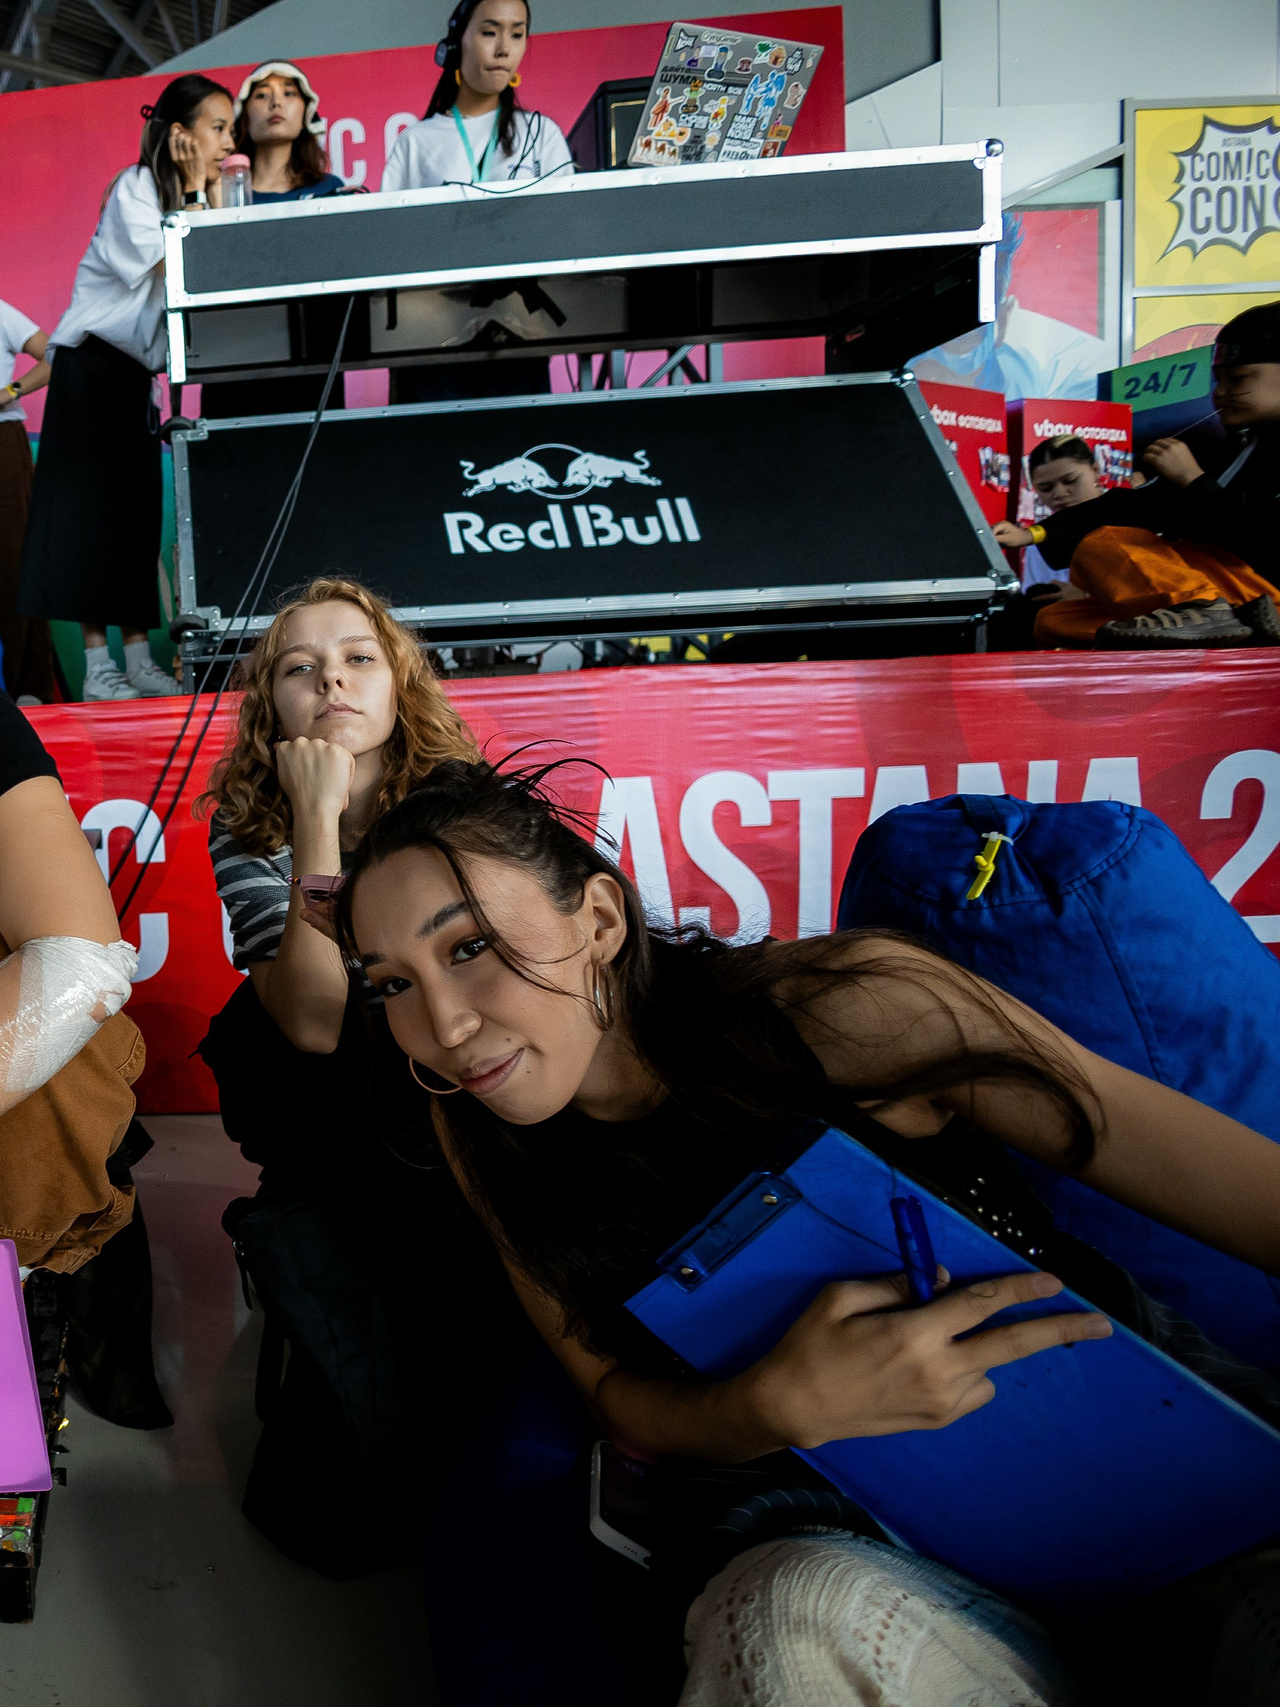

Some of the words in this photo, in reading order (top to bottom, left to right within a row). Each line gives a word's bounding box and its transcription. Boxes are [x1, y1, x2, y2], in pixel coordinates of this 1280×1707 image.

[1190, 185, 1266, 235] CON
[1124, 361, 1198, 400] 24/7
[442, 503, 571, 555] Red
[572, 497, 701, 548] Bull
[592, 756, 1144, 950] AST
